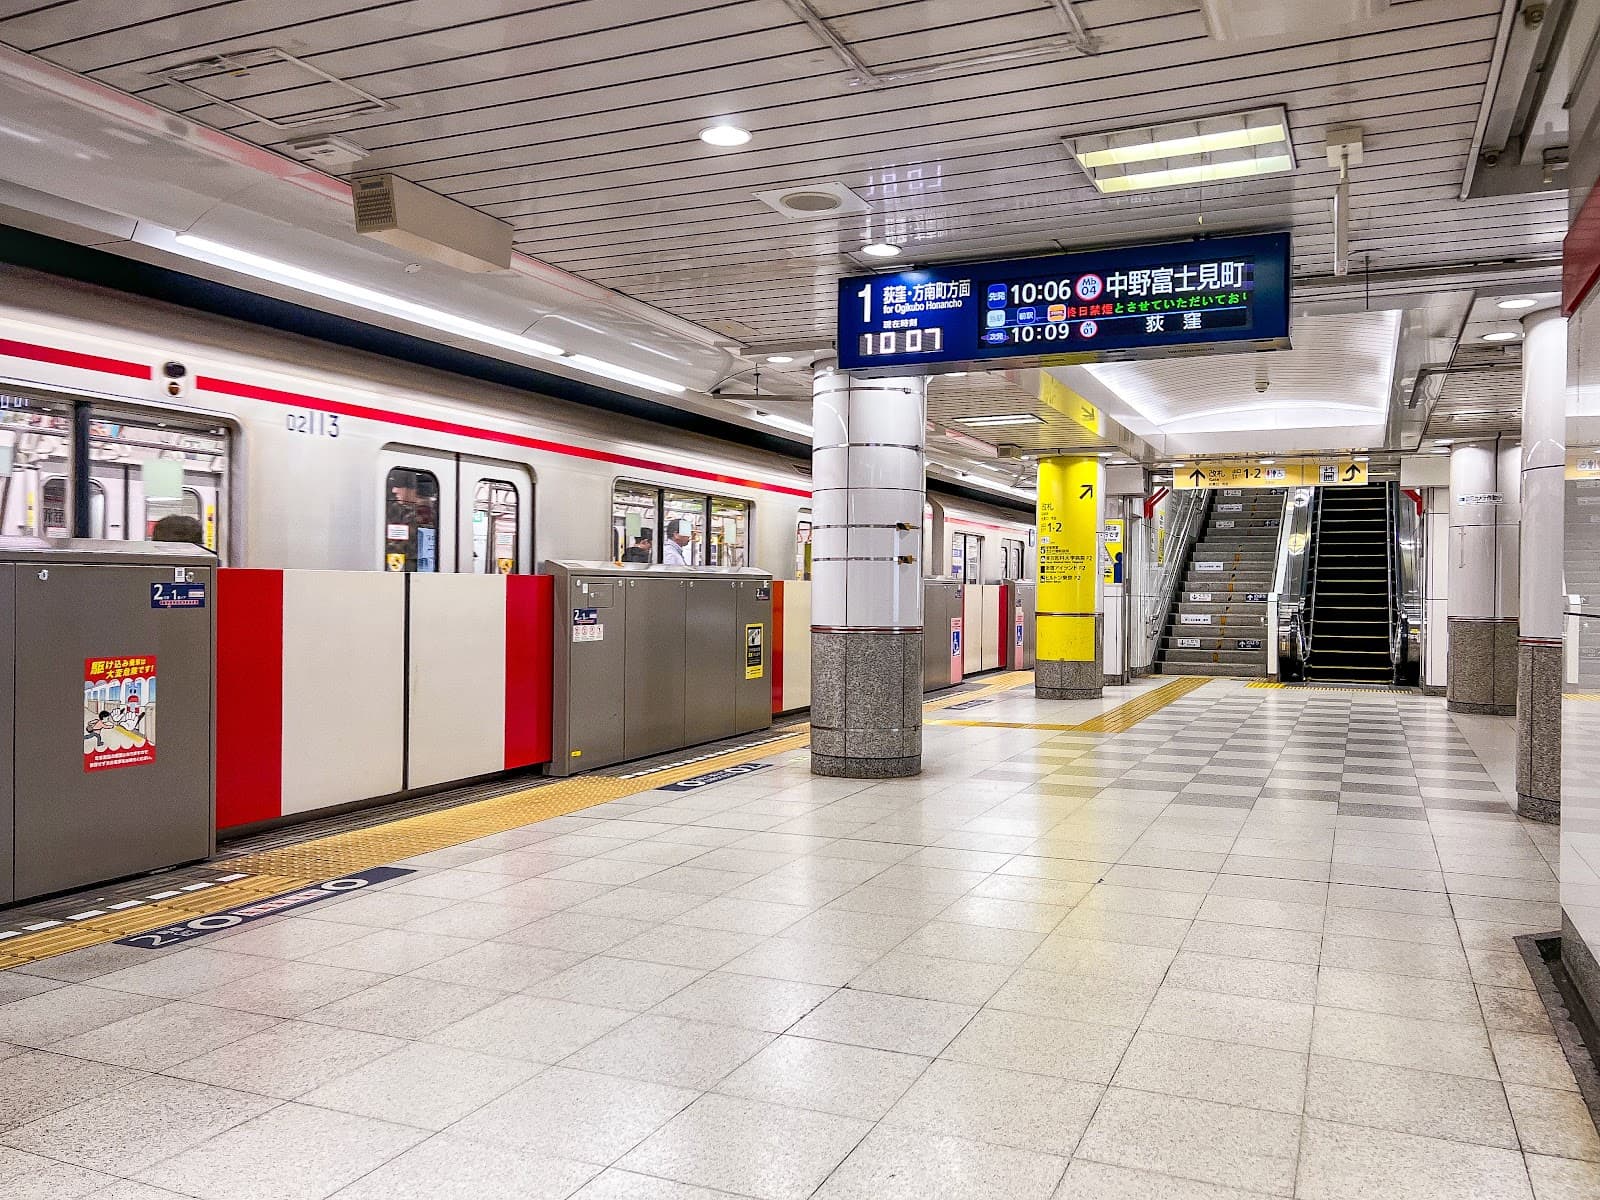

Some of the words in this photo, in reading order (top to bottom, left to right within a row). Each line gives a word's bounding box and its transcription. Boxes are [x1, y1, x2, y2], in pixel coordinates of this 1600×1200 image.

[1081, 286, 1097, 296] 04
[1106, 261, 1245, 299] 中野富士見町
[857, 283, 872, 323] 1
[1010, 279, 1072, 305] 10:06
[883, 305, 894, 315] for
[895, 302, 924, 315] Ogikubo
[926, 299, 963, 311] Honancho
[1011, 323, 1070, 343] 10:09
[1083, 327, 1094, 335] 01
[286, 411, 340, 438] 02113
